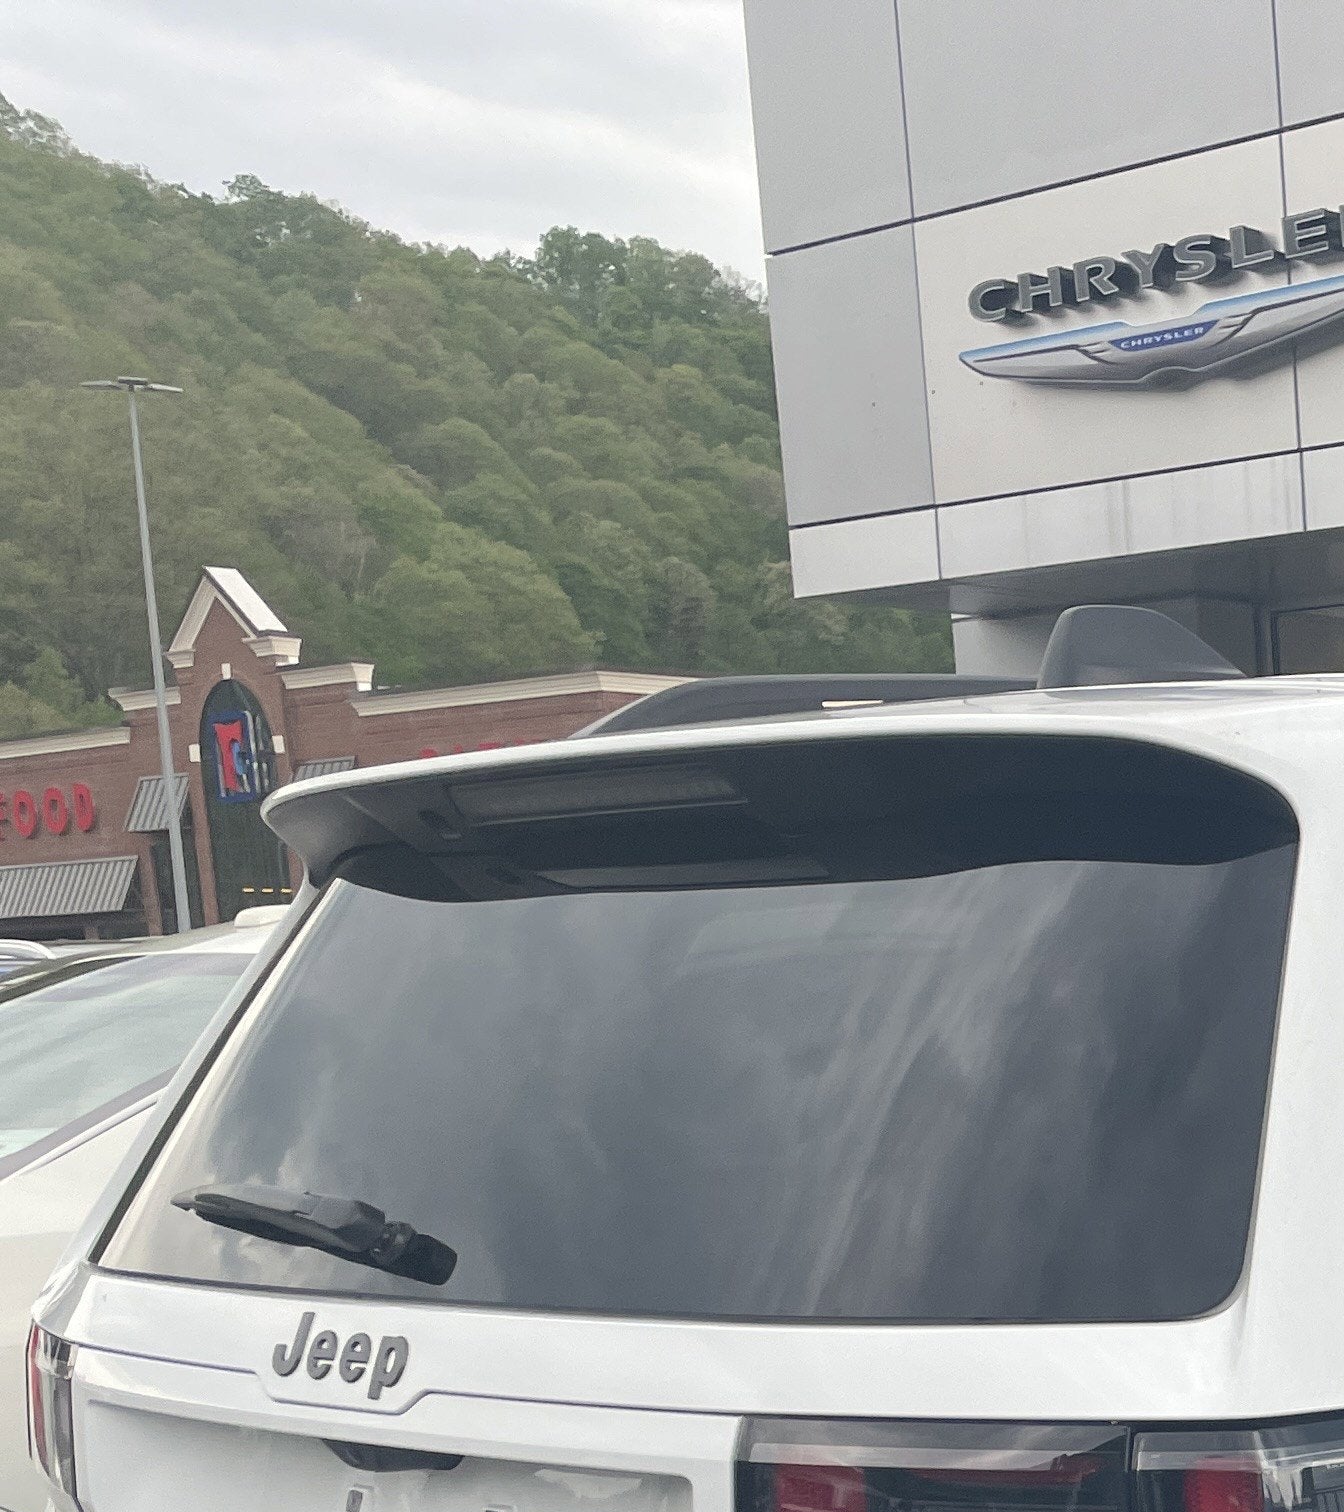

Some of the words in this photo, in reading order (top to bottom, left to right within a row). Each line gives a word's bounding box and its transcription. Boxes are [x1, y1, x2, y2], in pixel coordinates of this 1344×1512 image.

[1120, 326, 1205, 349] CHRYSLER
[0, 783, 94, 837] OOD
[271, 1311, 410, 1400] Jeep
